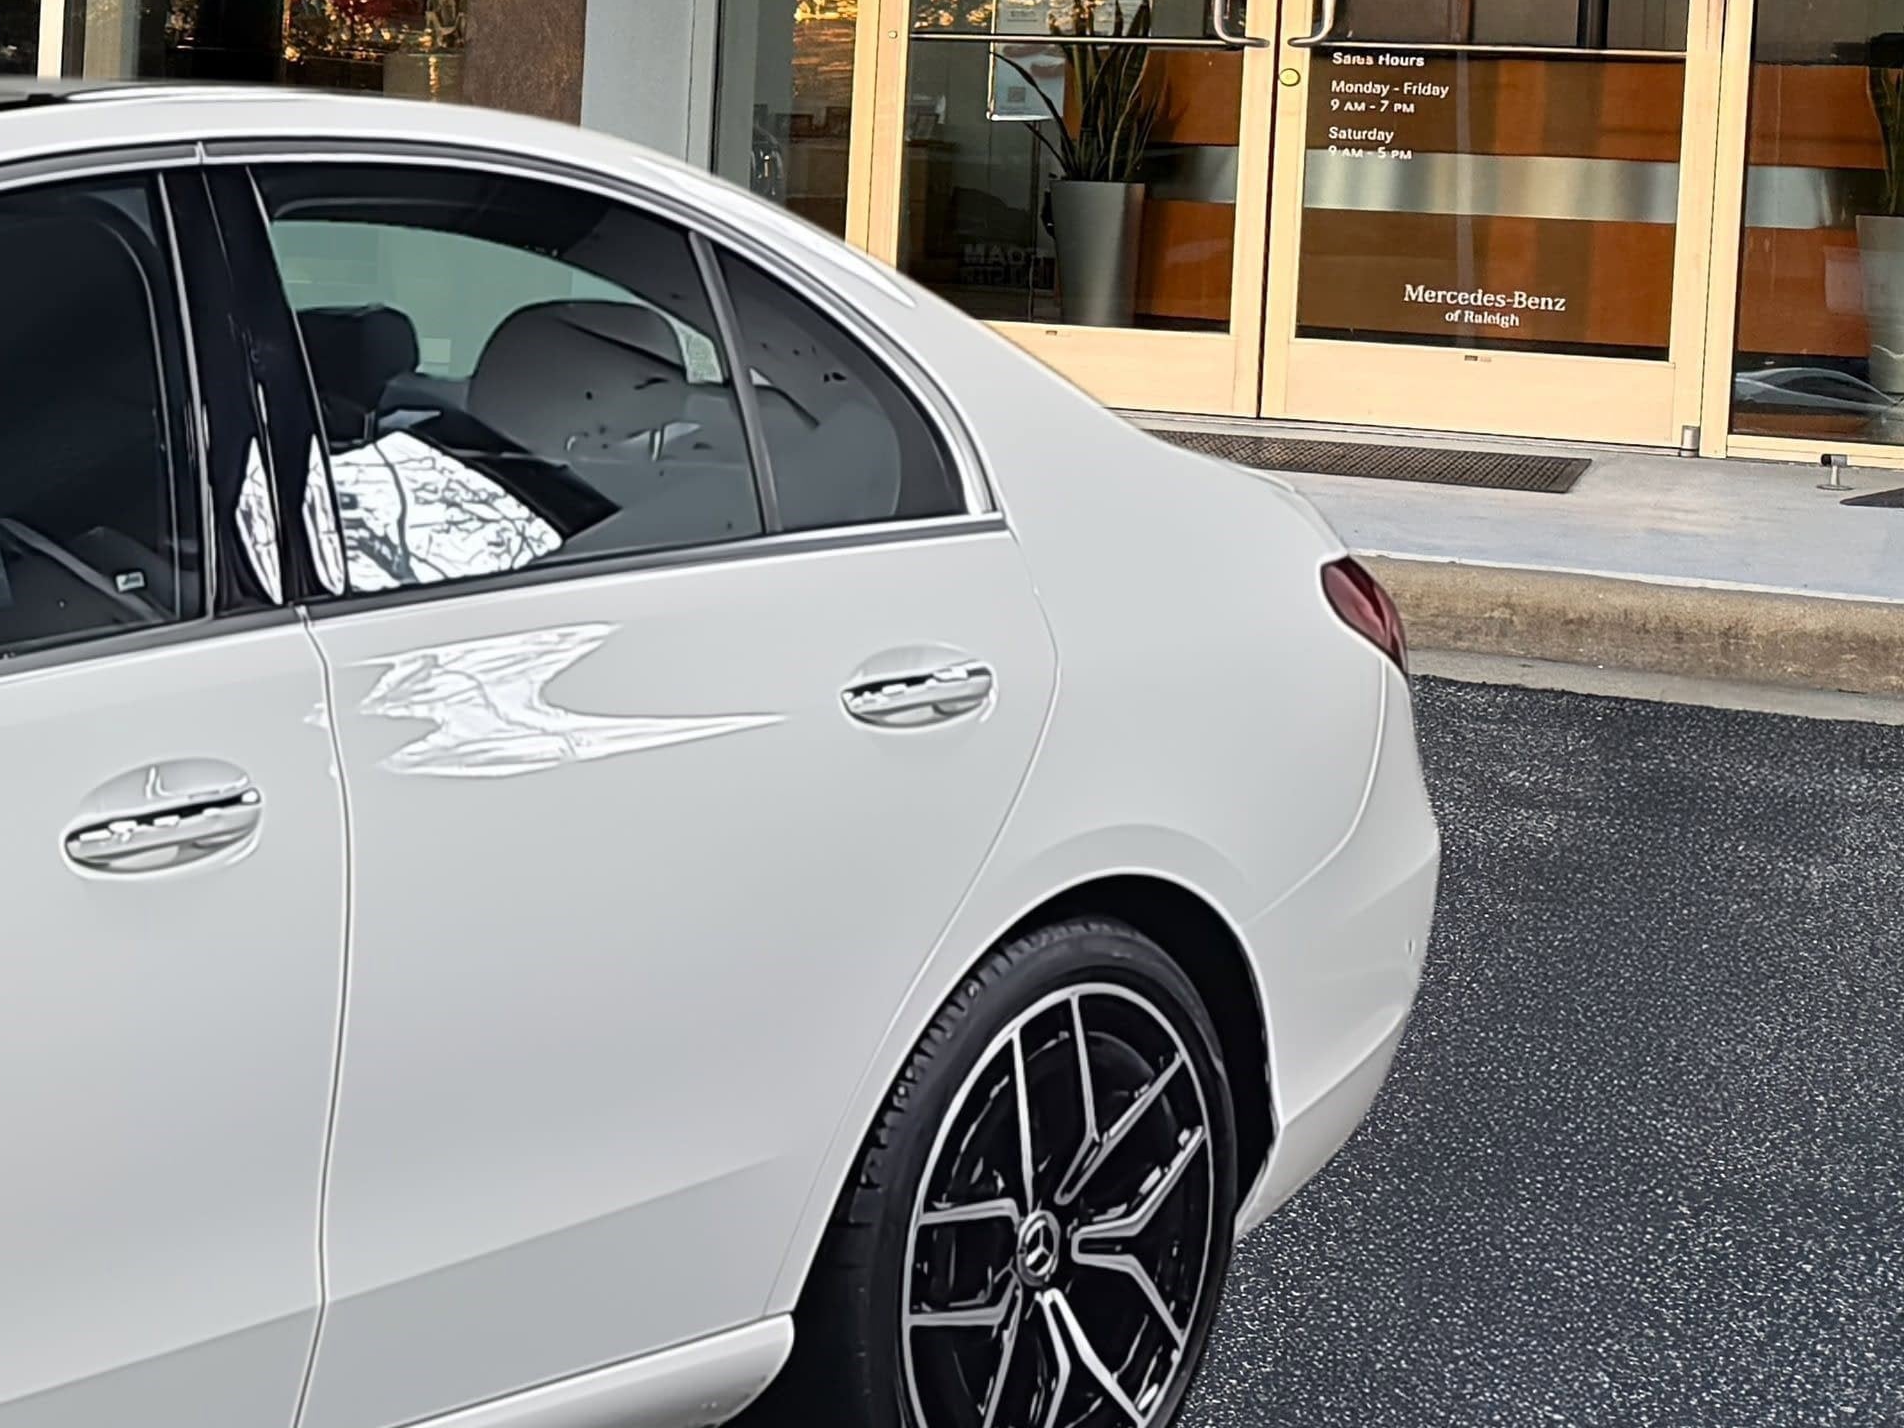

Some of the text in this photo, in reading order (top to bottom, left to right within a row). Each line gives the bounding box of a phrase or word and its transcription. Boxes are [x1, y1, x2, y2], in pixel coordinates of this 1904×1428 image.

[1378, 53, 1425, 67] Hours
[1331, 80, 1390, 97] Monday
[1403, 82, 1450, 98] Friday
[1330, 98, 1340, 111] 9
[1343, 102, 1366, 112] AM
[1379, 100, 1389, 112] 7
[1393, 103, 1415, 113] PM
[1328, 126, 1394, 144] Saturday
[1342, 148, 1363, 158] AM
[1377, 147, 1387, 159] 5
[1391, 150, 1412, 160] PM
[1403, 284, 1566, 311] Mercedes-Benz
[1445, 310, 1462, 322] of
